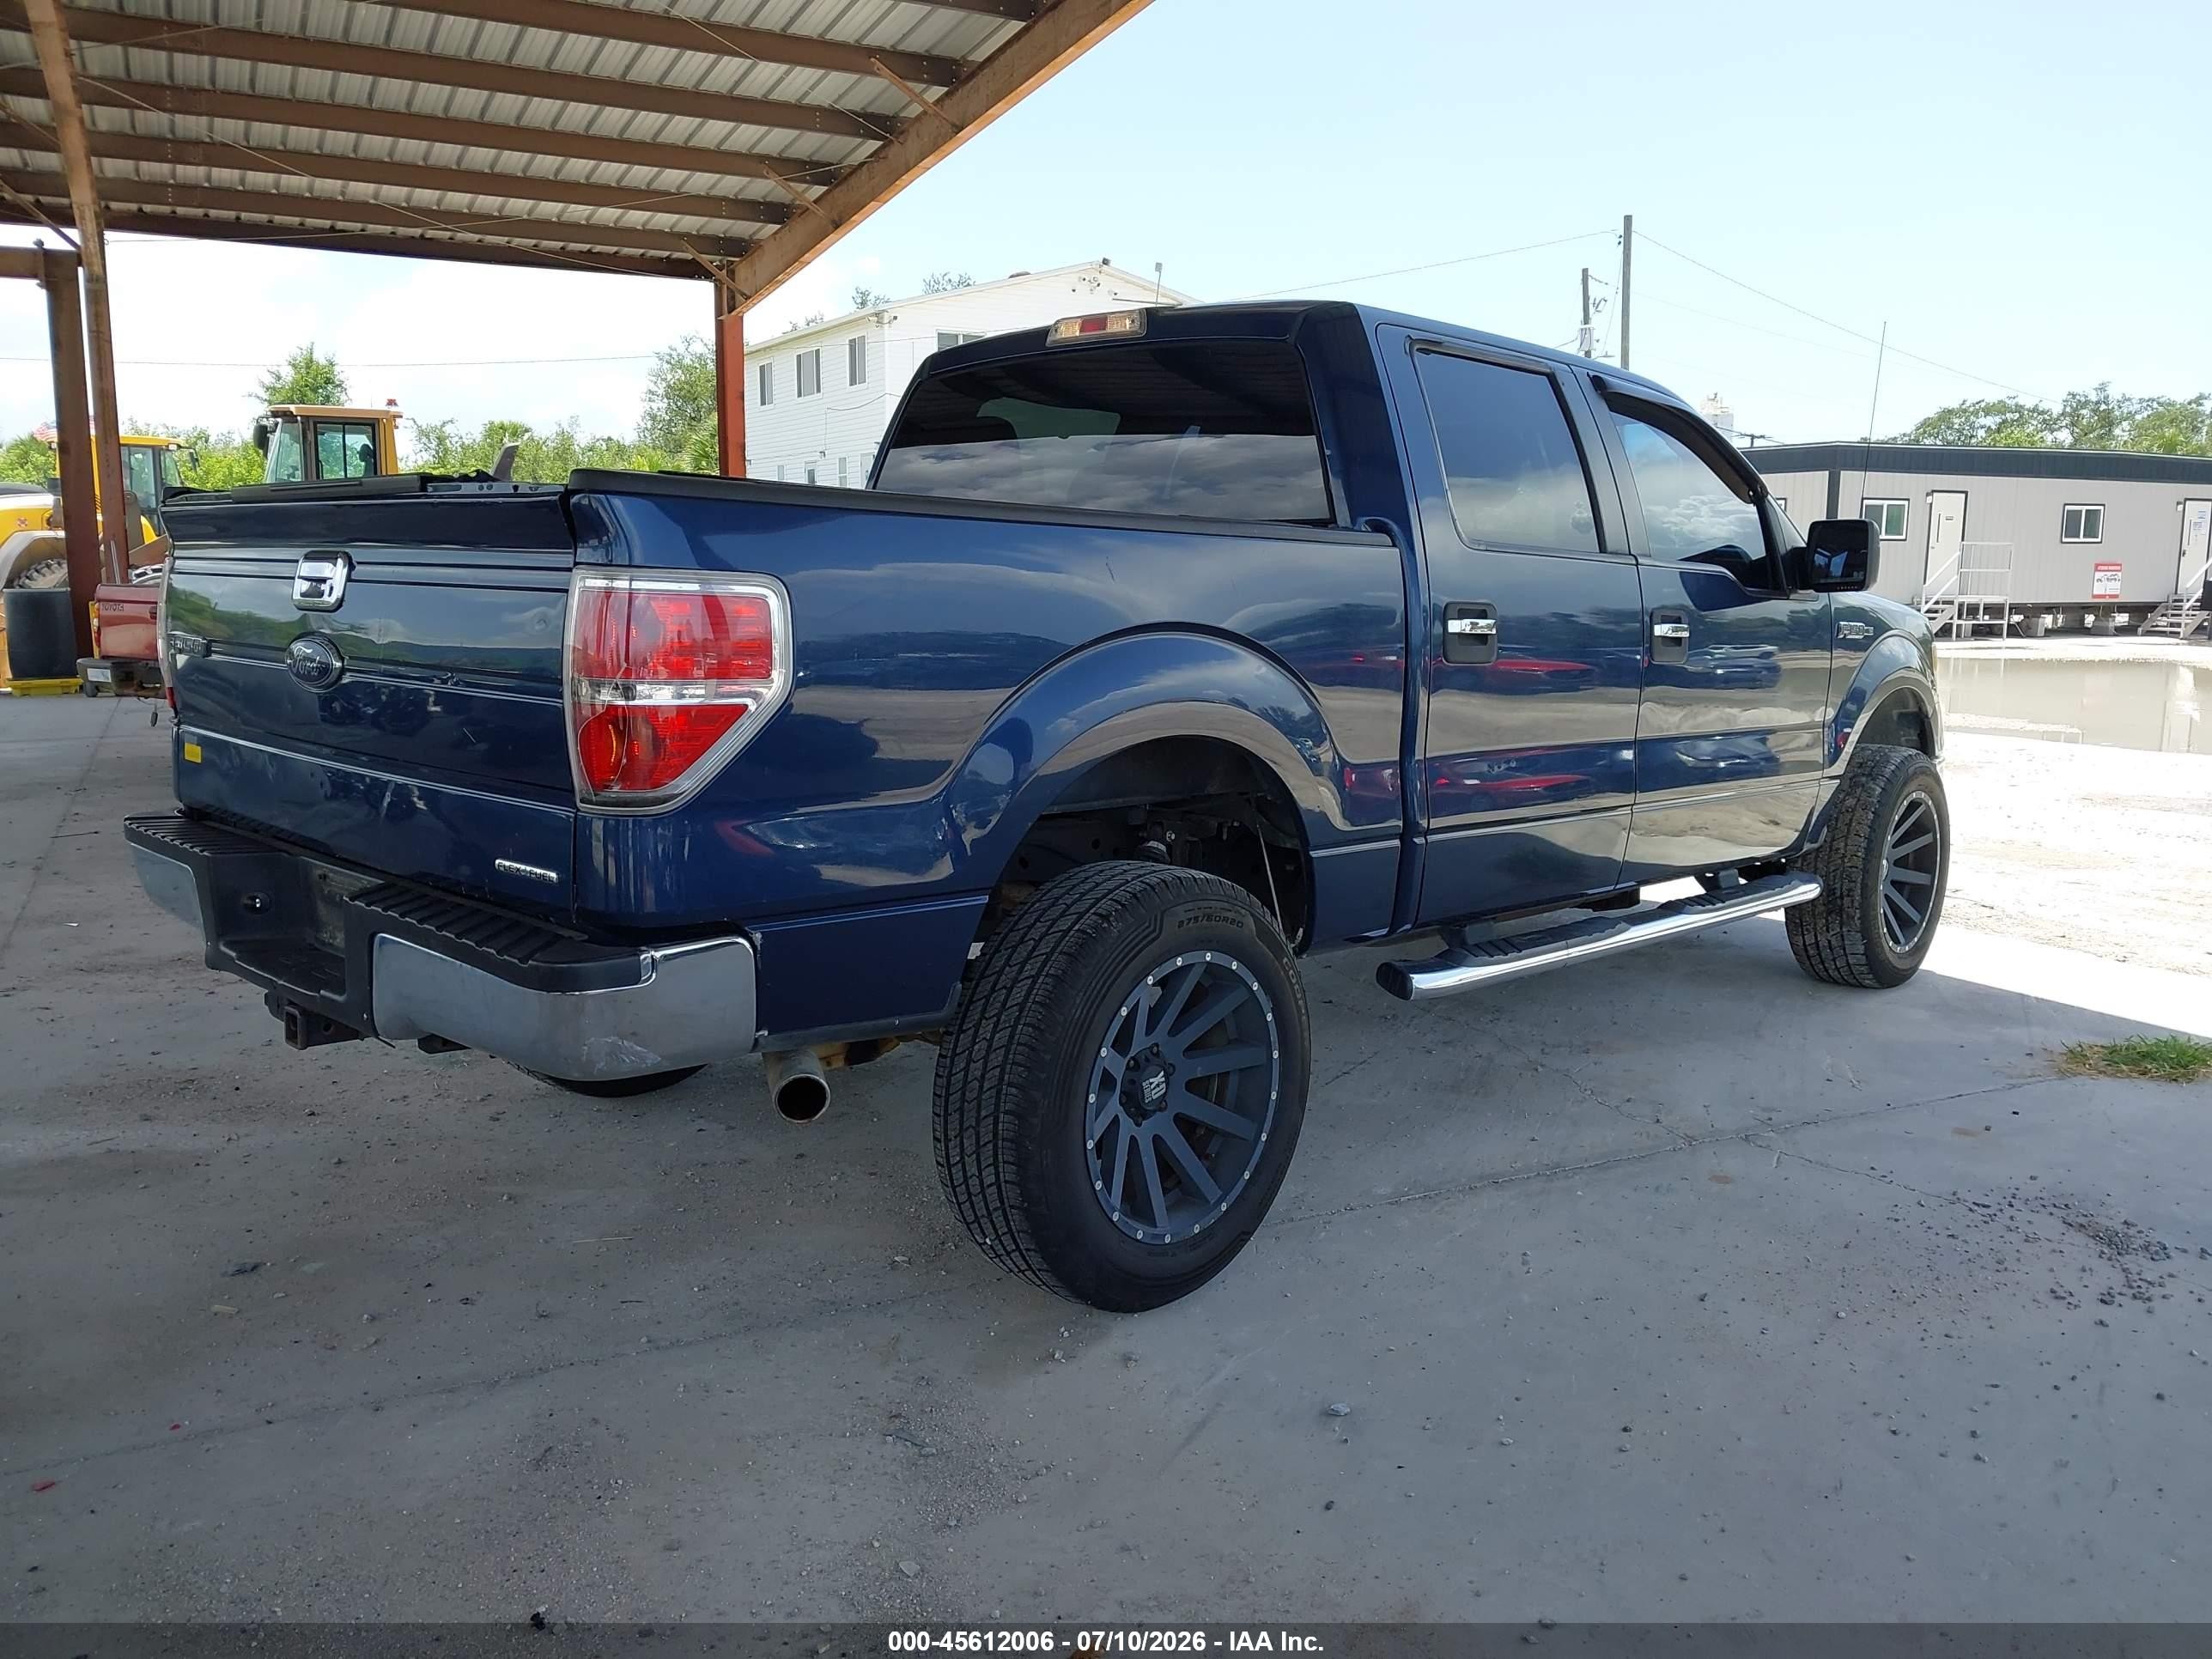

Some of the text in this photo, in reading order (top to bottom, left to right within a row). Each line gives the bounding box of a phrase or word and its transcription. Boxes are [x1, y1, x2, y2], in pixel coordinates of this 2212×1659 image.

[291, 646, 327, 676] Ford
[497, 861, 556, 884] FLEX FUEL
